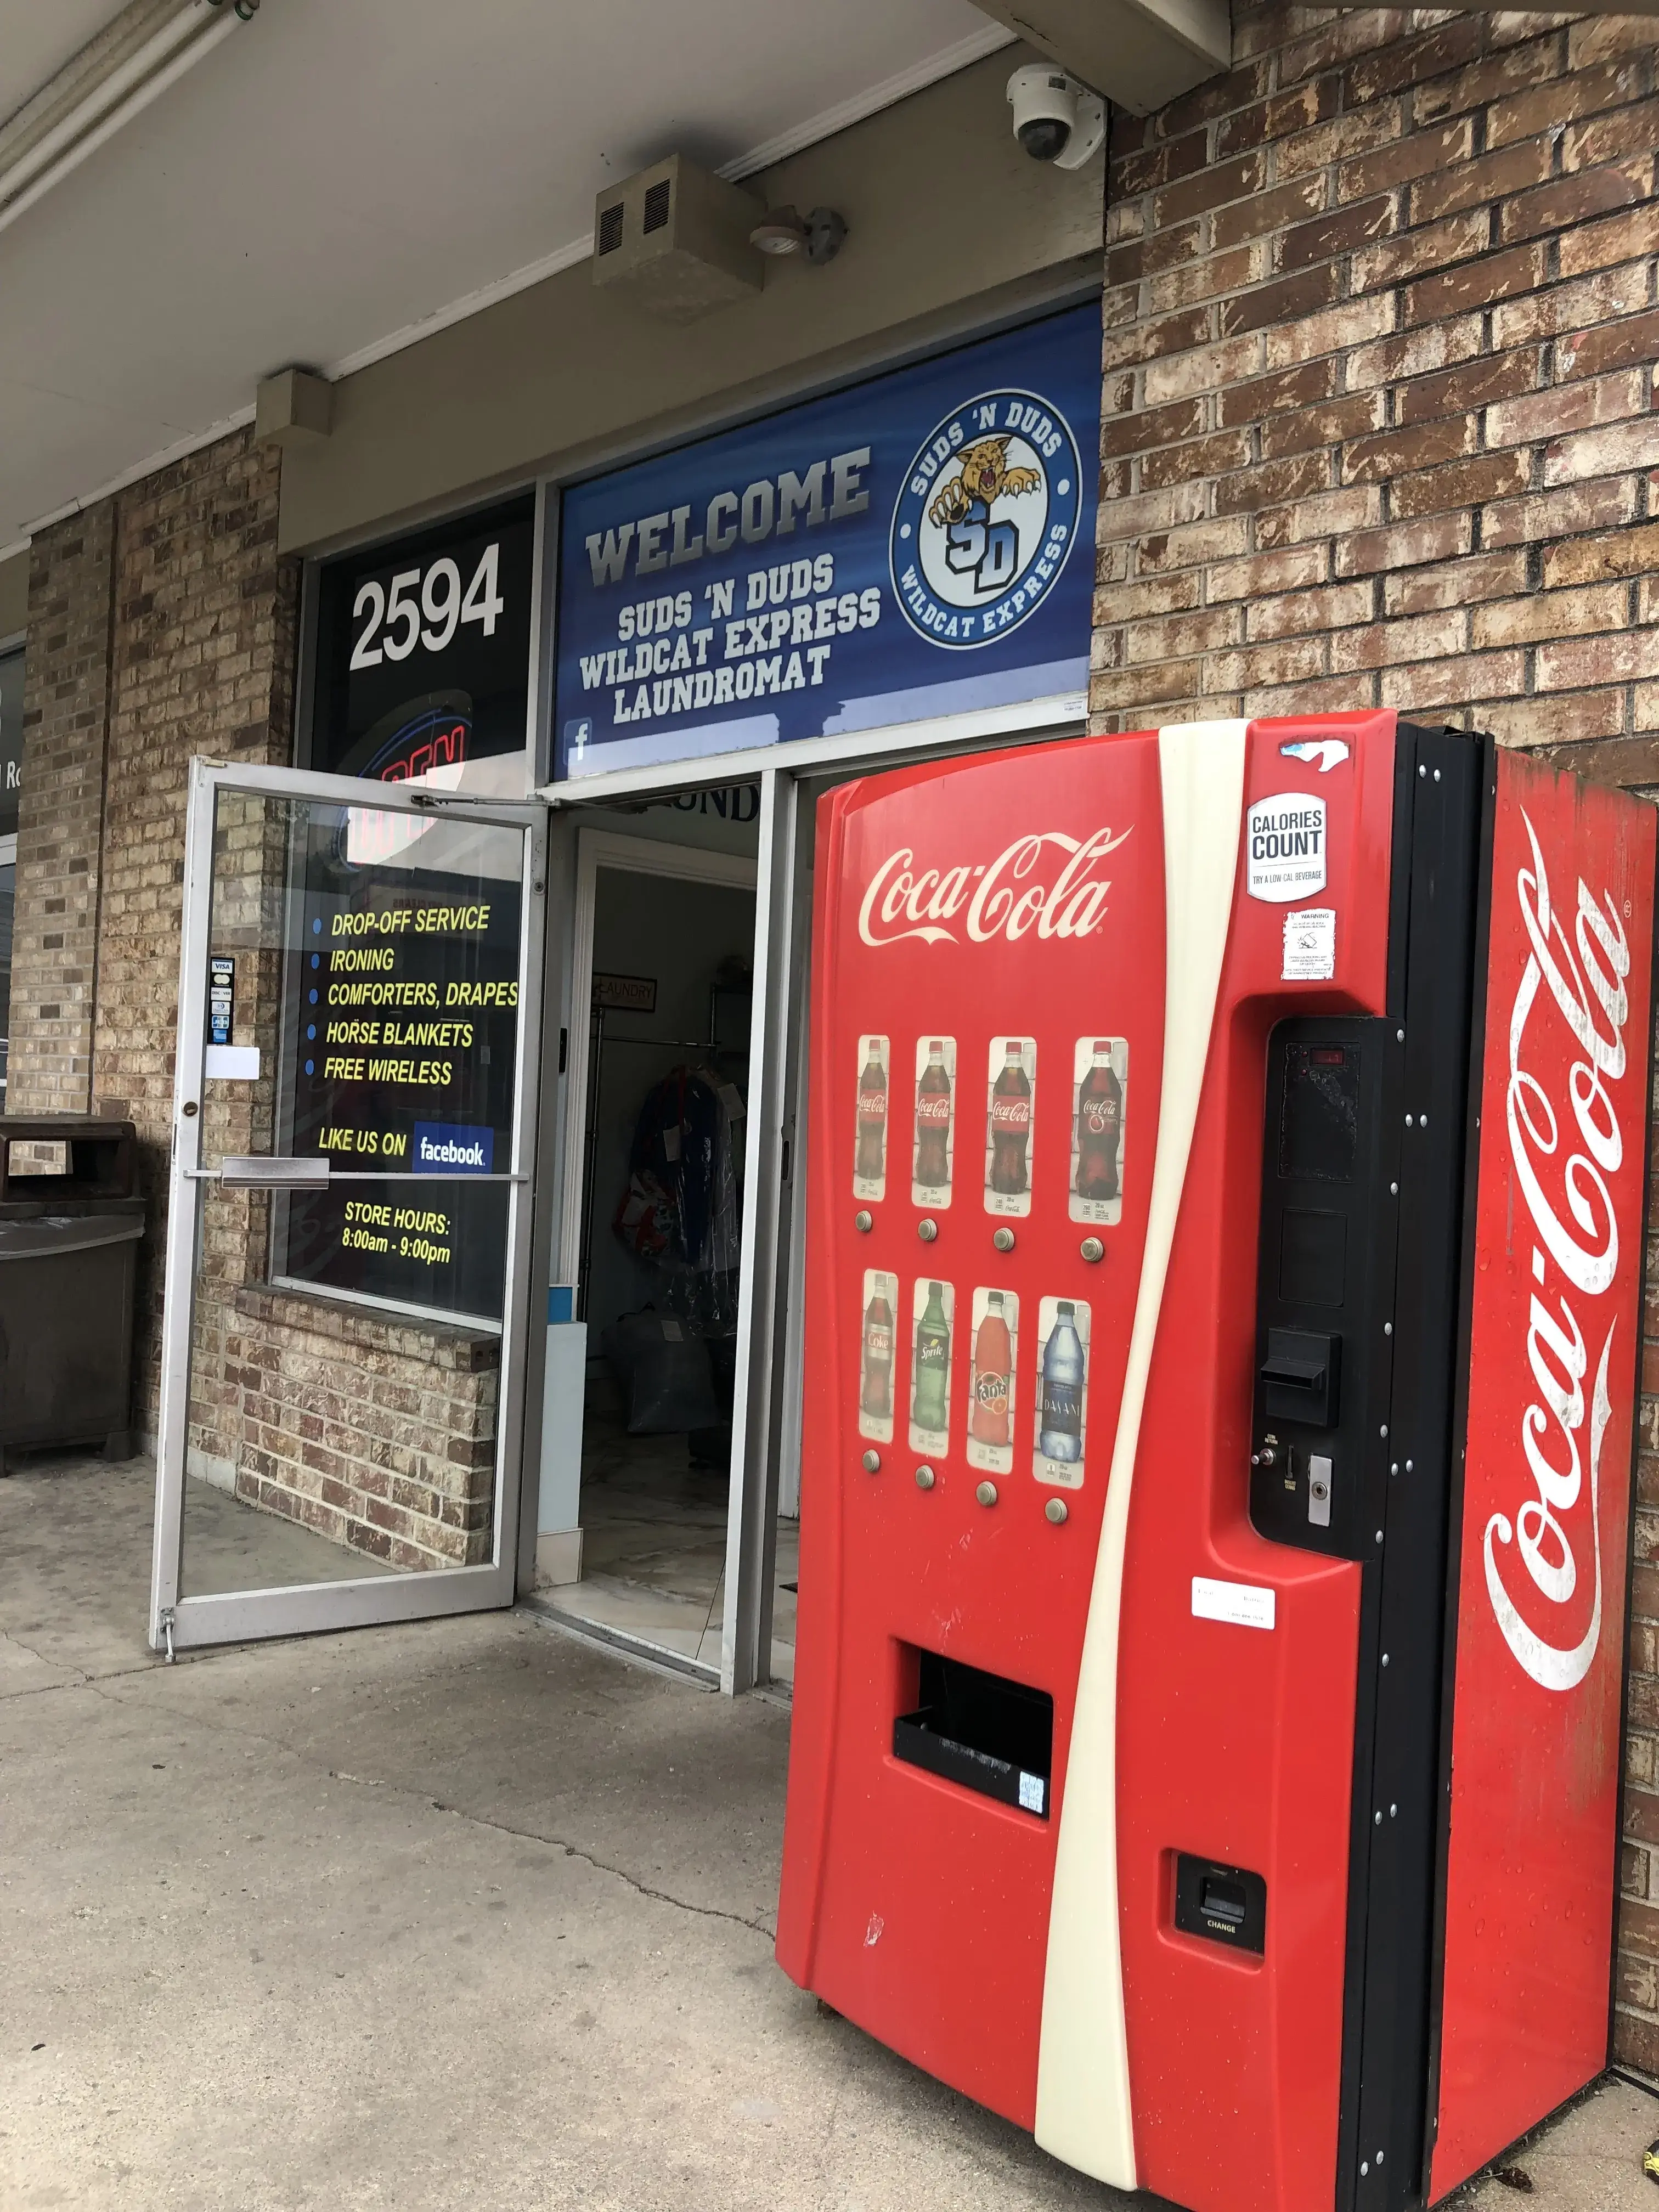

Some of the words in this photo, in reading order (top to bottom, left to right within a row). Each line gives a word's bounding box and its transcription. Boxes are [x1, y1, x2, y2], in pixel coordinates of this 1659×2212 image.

[911, 422, 964, 496] SUDS
[1005, 402, 1062, 458] DUDS
[585, 446, 871, 588] WELCOME
[901, 564, 974, 638] WILDCAT
[983, 523, 1067, 634] EXPRESS
[349, 542, 504, 672] 2594
[618, 590, 693, 641] SUDS
[747, 553, 833, 611] DUDS
[580, 628, 713, 691] WILDCAT
[724, 587, 881, 660] EXPRESS
[613, 645, 831, 724] LAUNDROMAT
[1252, 810, 1322, 833] CALORIES
[1252, 830, 1322, 860] COUNT
[858, 823, 1136, 946] Coca-Cola
[1253, 876, 1263, 885] TRY
[1264, 874, 1268, 883] A
[1269, 872, 1294, 884] LOW-CAL
[1295, 870, 1322, 882] BEVERAGE
[331, 910, 413, 936] DROP-OFF
[415, 906, 491, 933] SERVICE
[330, 948, 395, 972] IRONING
[328, 982, 441, 1009] COMFORTERS,
[445, 982, 518, 1006] DRAPES
[599, 981, 653, 999] LAUNDRY
[326, 1022, 379, 1044] HORSE
[382, 1023, 474, 1047] BLANKETS
[324, 1057, 365, 1080] FREE
[368, 1059, 453, 1085] WIRELESS
[860, 1094, 885, 1113] Coca-Cola
[918, 1098, 949, 1118] Coca-Cola
[992, 1101, 1030, 1122] Coca-Cola
[1084, 1099, 1116, 1115] Coca-Cola
[319, 1127, 354, 1151] LIKE
[357, 1130, 378, 1153] US
[382, 1133, 407, 1156] ON
[420, 1136, 486, 1166] facebook
[345, 1201, 391, 1226] STORE
[393, 1208, 451, 1235] HOURS:
[342, 1227, 388, 1253] 8:00am
[399, 1237, 451, 1265] 9:00pm
[1483, 804, 1630, 1690] Coca-Cola
[868, 1332, 889, 1349] Coke
[921, 1345, 943, 1361] Sprite
[1045, 1398, 1080, 1417] DASANI
[1207, 1920, 1236, 1933] CHANGE
